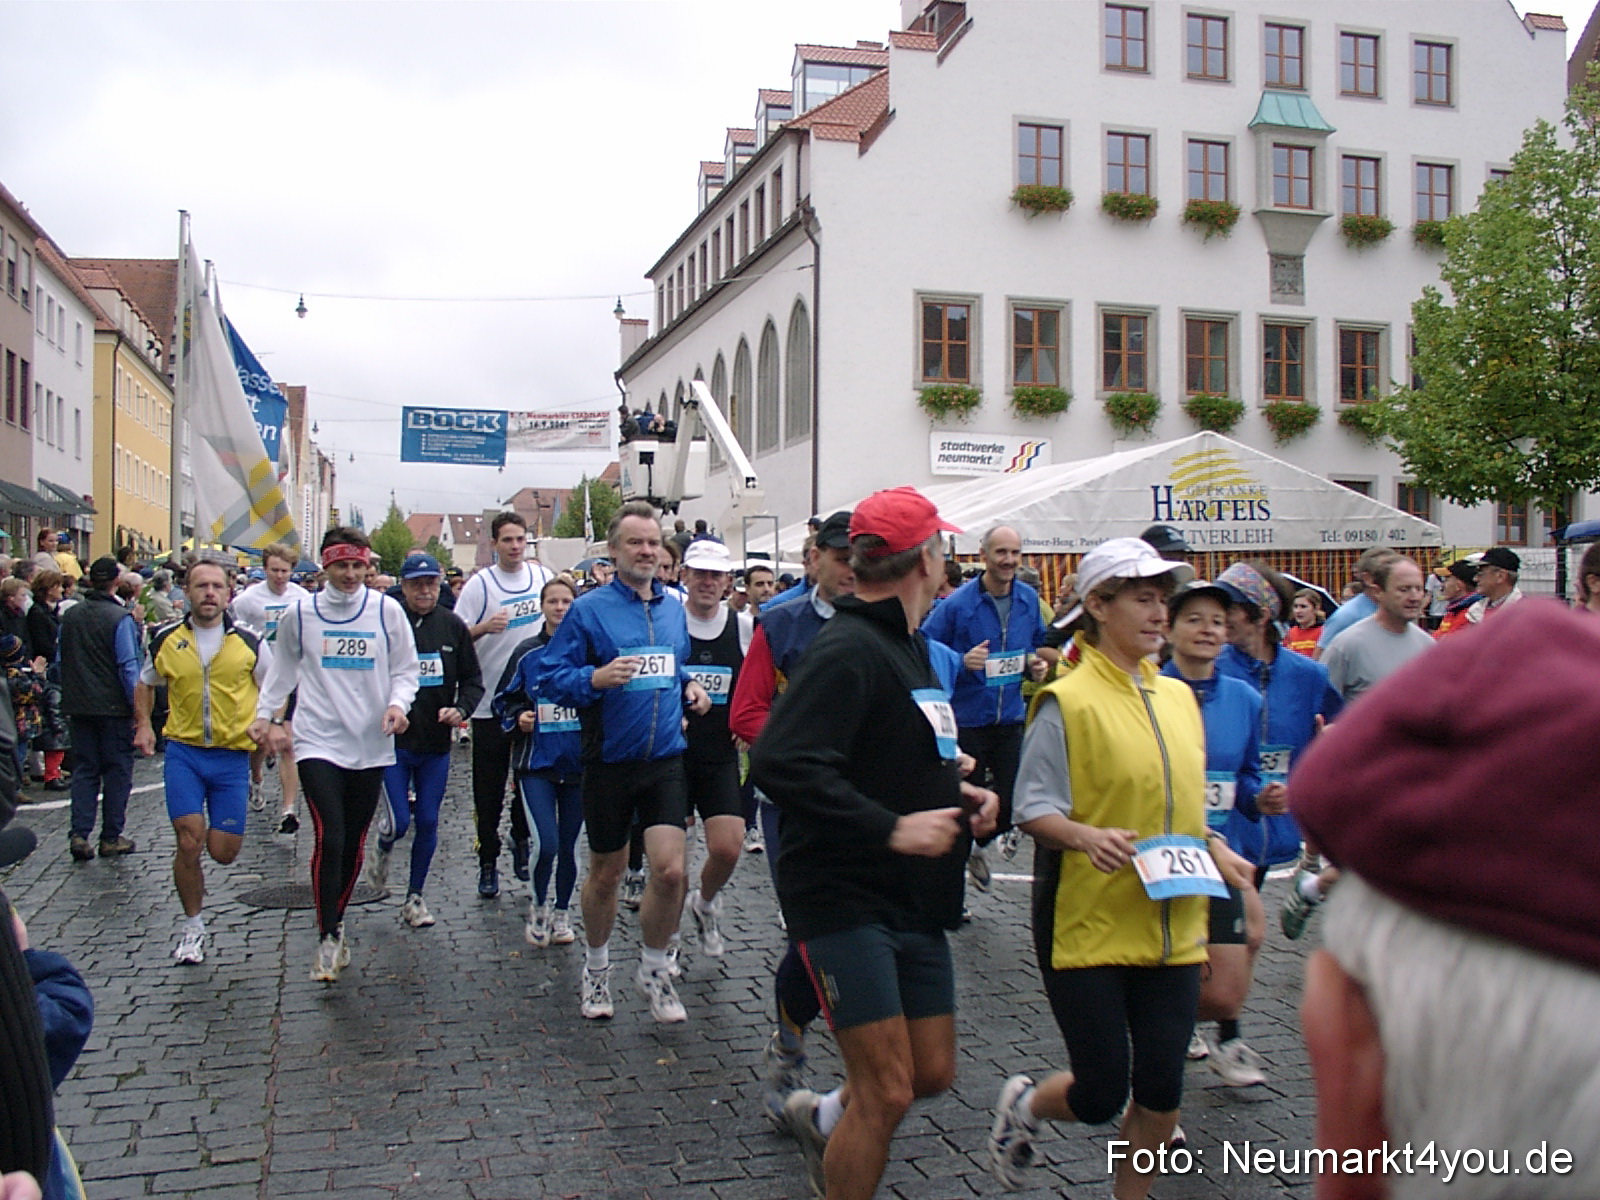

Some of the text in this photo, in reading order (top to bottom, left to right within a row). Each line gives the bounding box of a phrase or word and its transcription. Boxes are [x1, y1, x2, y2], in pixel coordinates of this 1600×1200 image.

[407, 409, 501, 433] BOCK
[940, 441, 1005, 454] stadtwerke
[937, 453, 993, 465] neumarkt
[1185, 528, 1273, 545] TVERLEIH
[1344, 528, 1378, 542] 09180
[1388, 528, 1406, 541] 402
[514, 600, 538, 618] 292
[337, 639, 367, 656] 289
[420, 661, 436, 675] 94
[639, 656, 666, 675] 267
[553, 705, 578, 721] 510
[1206, 783, 1222, 807] 3
[1161, 848, 1208, 875] 261
